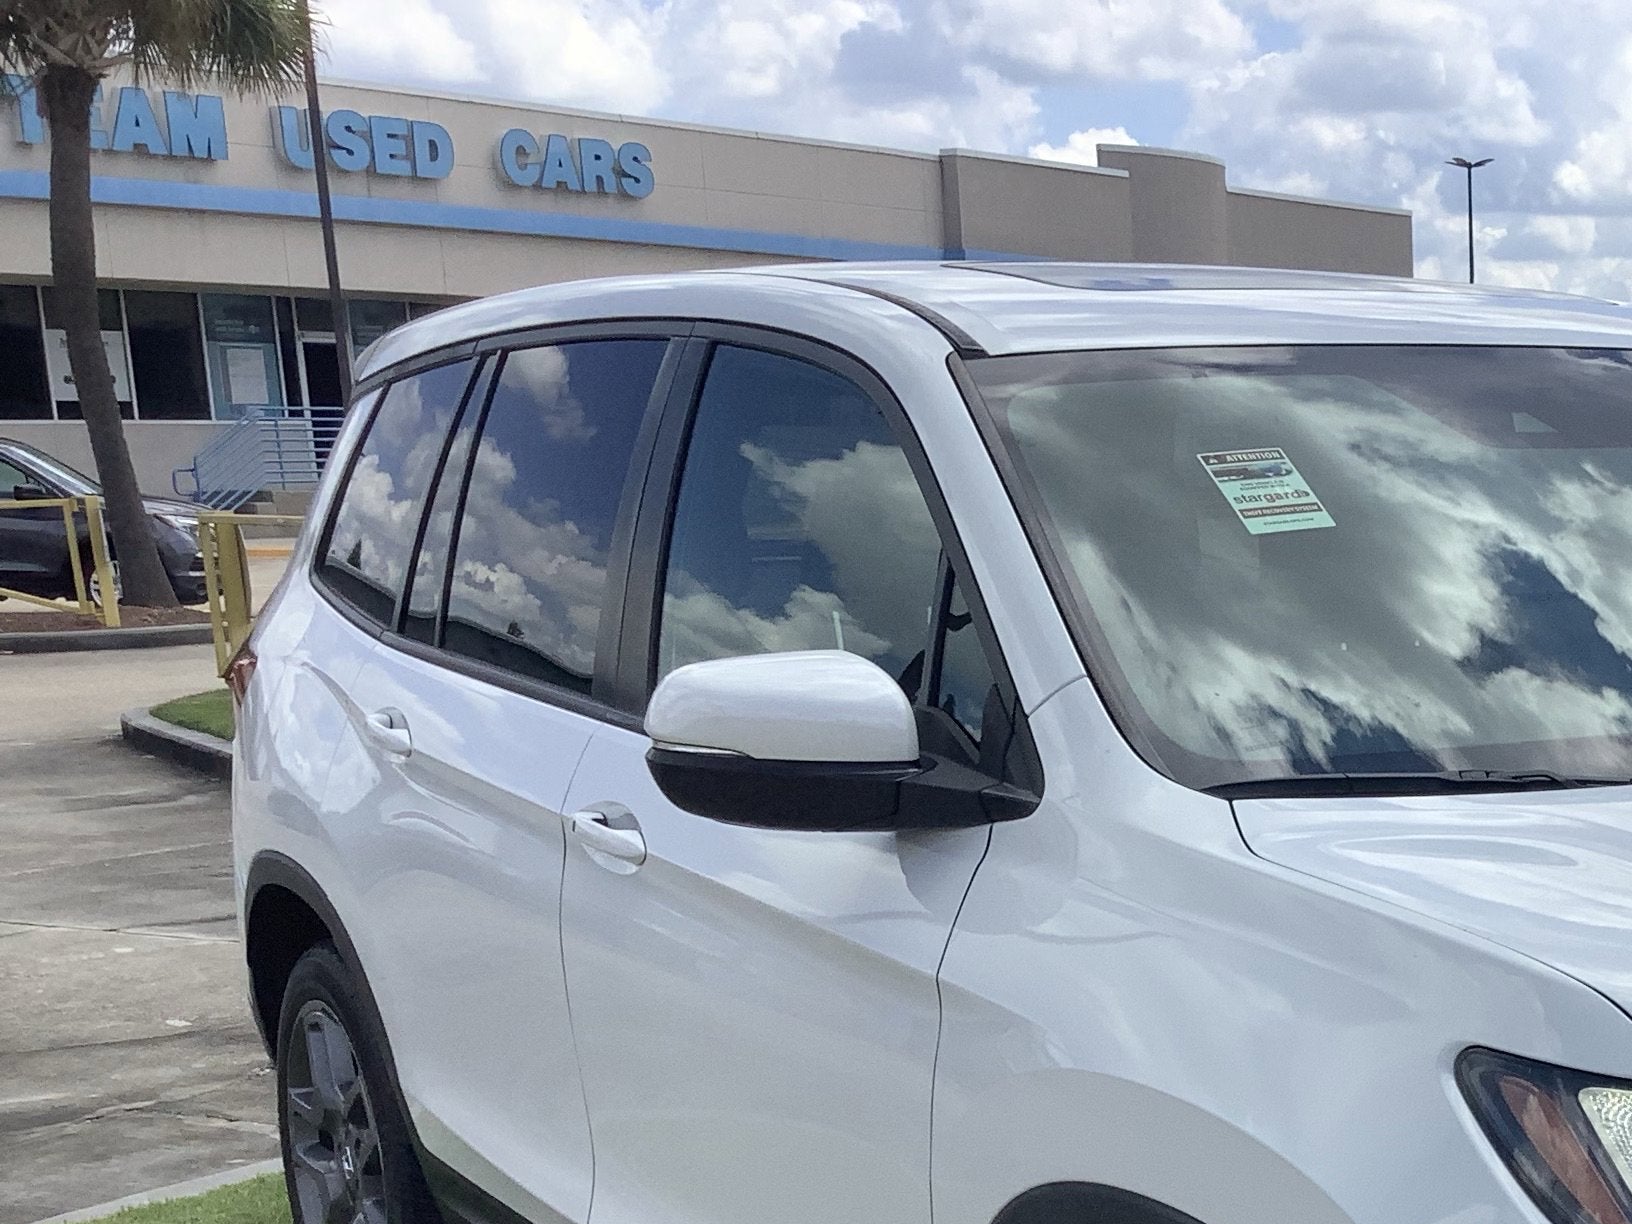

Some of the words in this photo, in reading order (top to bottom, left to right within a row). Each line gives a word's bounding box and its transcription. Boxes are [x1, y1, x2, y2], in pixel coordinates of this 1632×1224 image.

[279, 105, 454, 179] USED
[501, 128, 655, 199] CARS
[1225, 451, 1281, 462] ATTENTION
